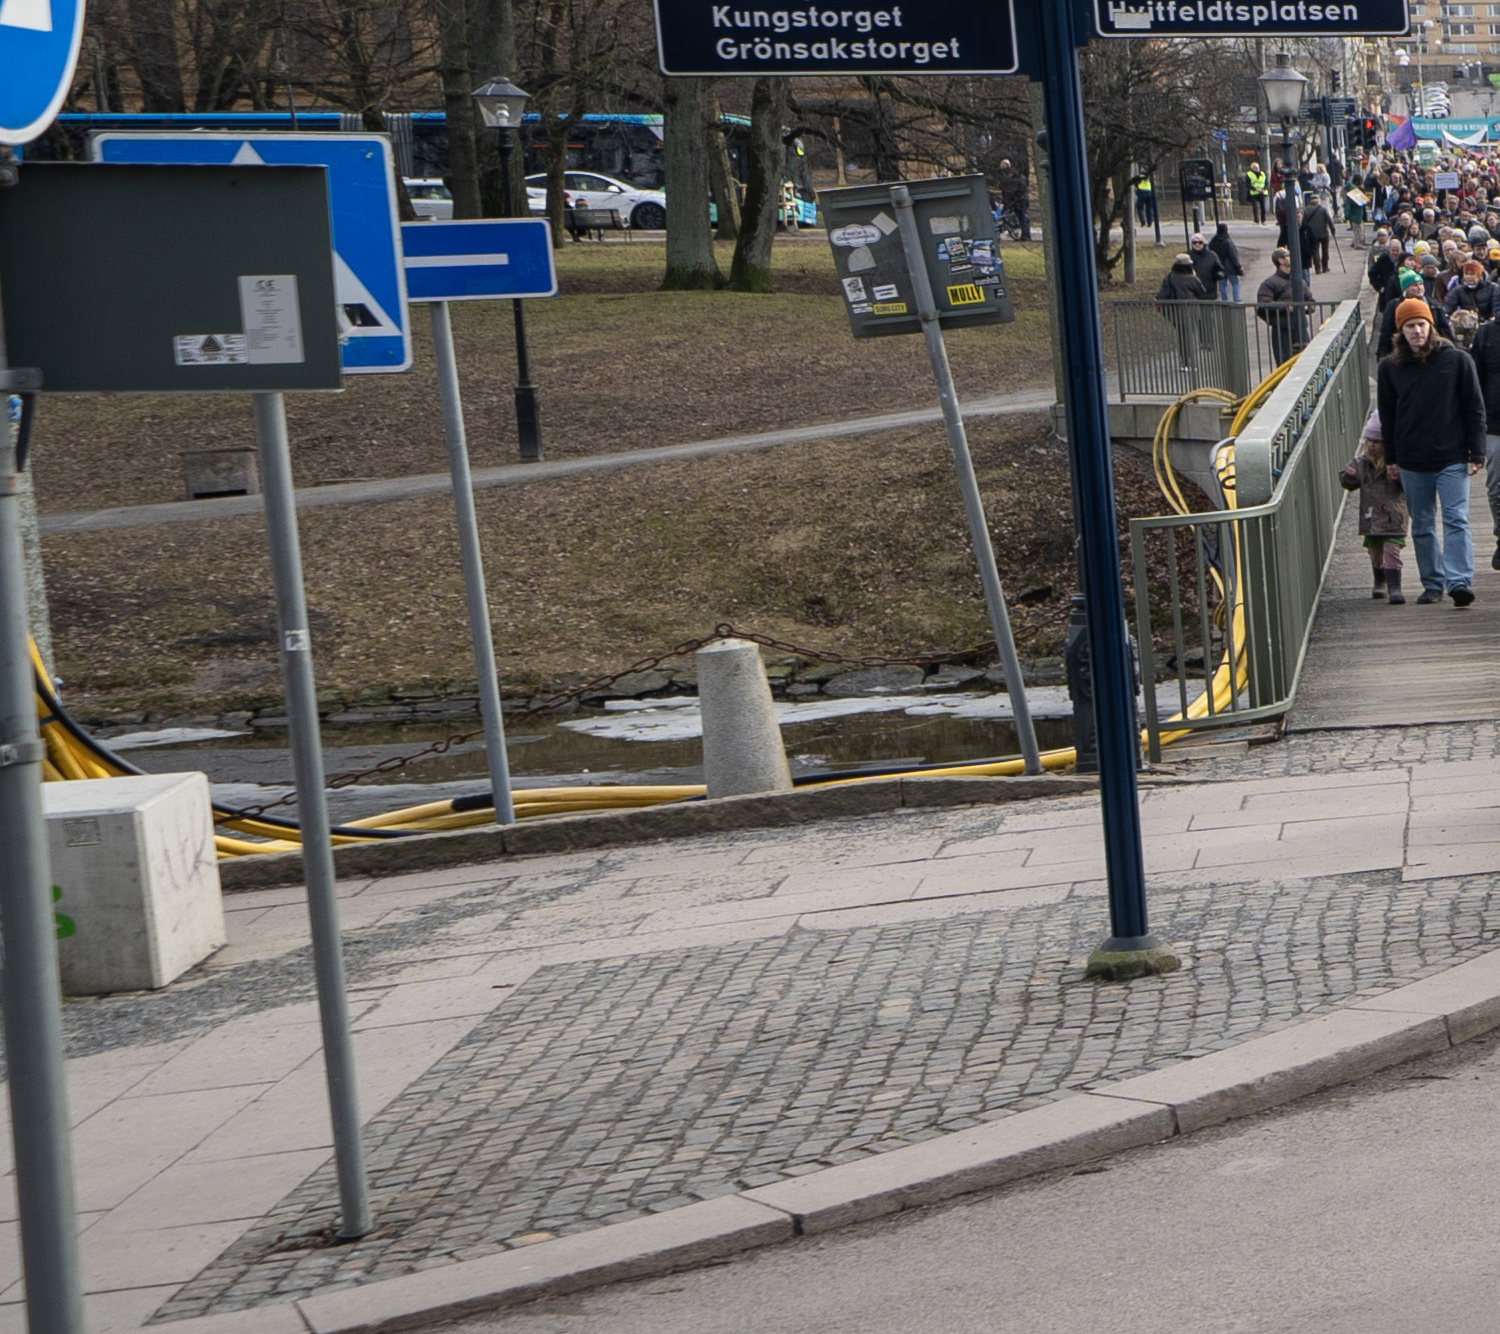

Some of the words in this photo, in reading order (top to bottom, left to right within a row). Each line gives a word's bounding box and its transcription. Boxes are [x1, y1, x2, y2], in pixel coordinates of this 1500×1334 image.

[712, 5, 902, 33] Kungstorget
[716, 37, 960, 64] Grönsakstorget
[950, 285, 983, 303] MULLY
